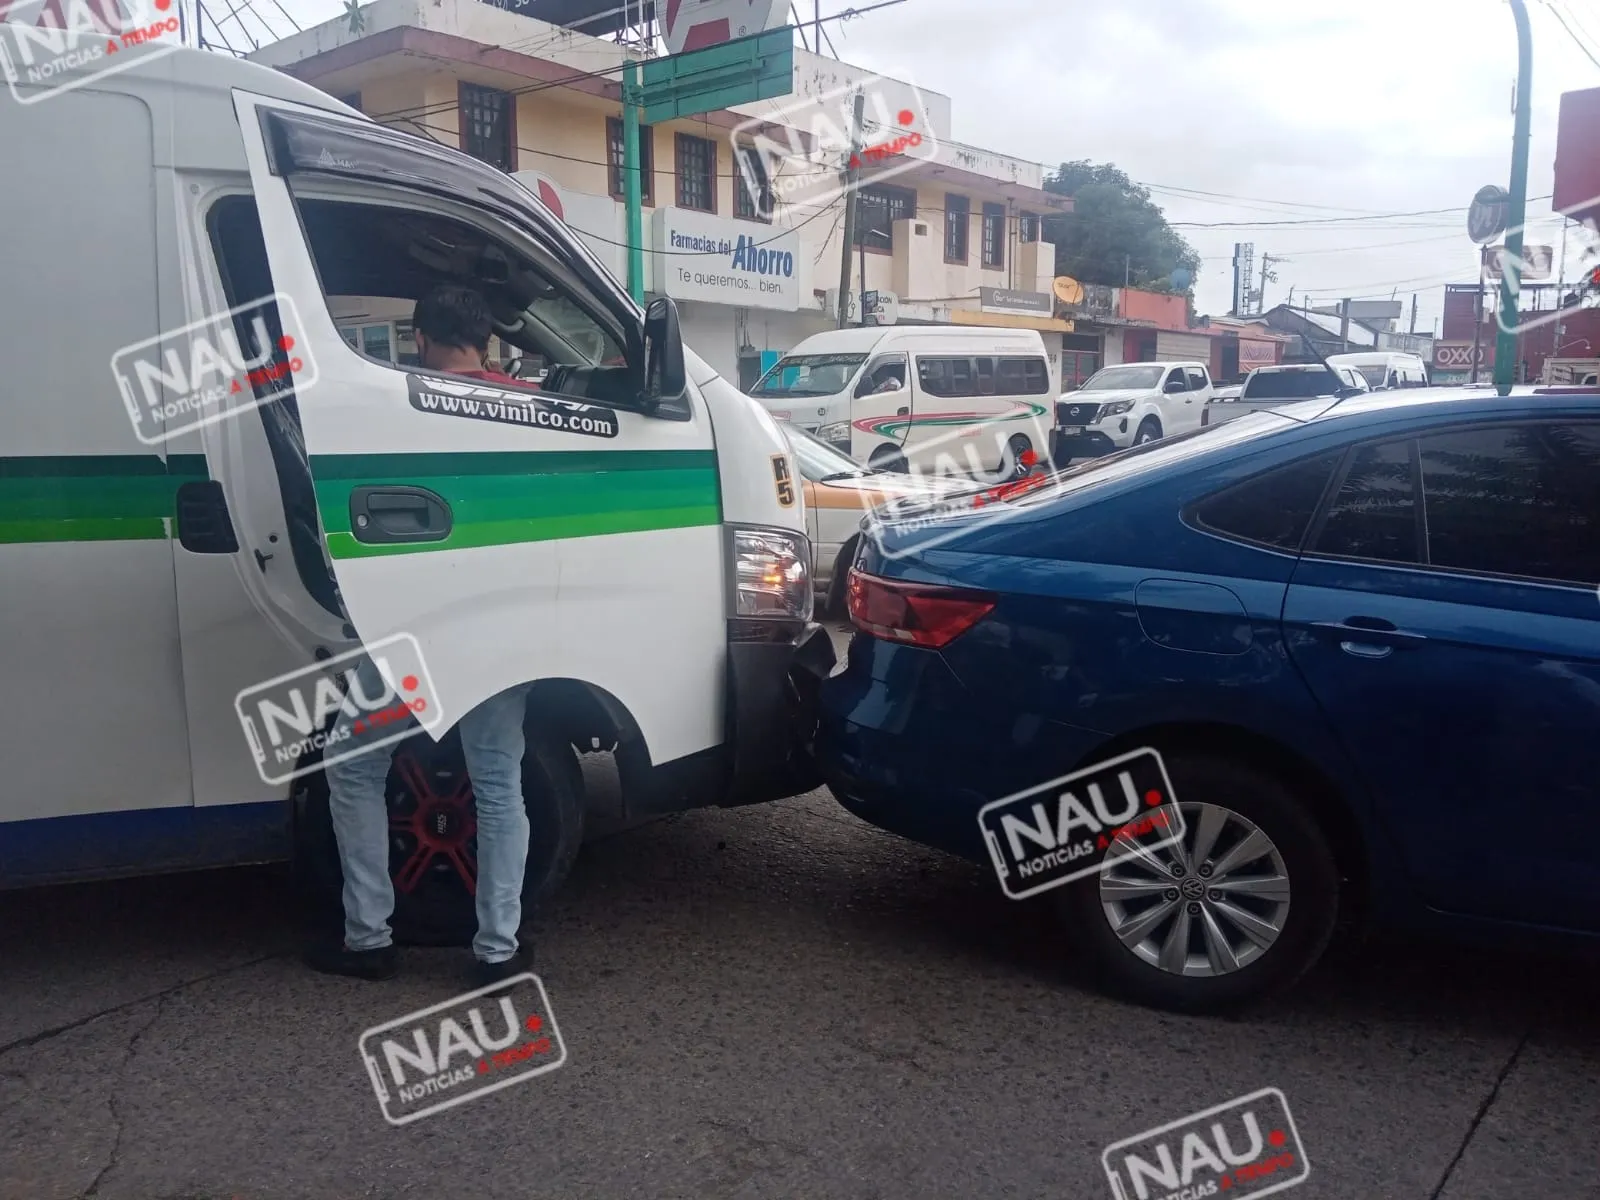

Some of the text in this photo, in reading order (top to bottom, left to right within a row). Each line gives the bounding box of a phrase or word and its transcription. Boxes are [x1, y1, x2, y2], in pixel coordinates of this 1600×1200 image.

[670, 229, 793, 278] Farmacias del Ahorro
[677, 267, 691, 283] Te
[1437, 345, 1483, 365] OXXO
[418, 392, 613, 435] www.vinilco.com
